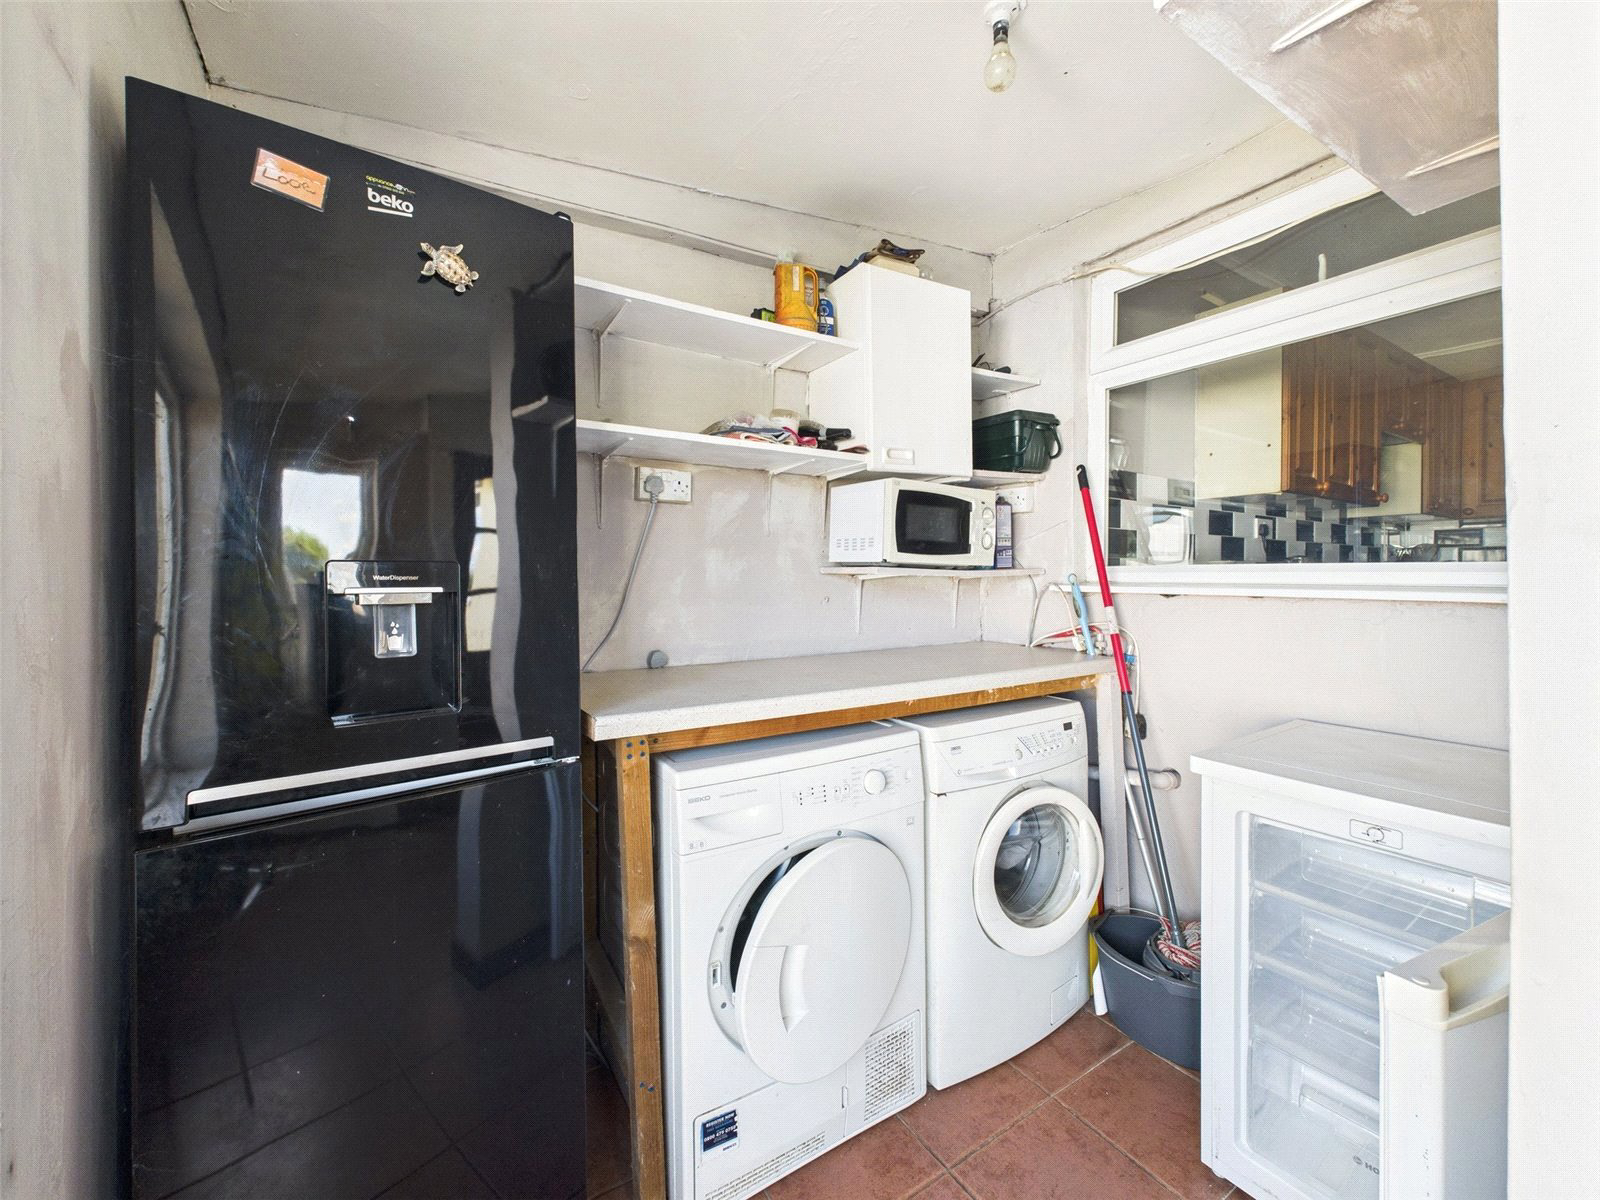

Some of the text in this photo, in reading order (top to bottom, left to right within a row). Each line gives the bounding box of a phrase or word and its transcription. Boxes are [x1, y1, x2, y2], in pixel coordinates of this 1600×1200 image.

[367, 187, 414, 213] beko
[372, 574, 419, 582] WaterDispenser
[687, 795, 711, 805] BEKO
